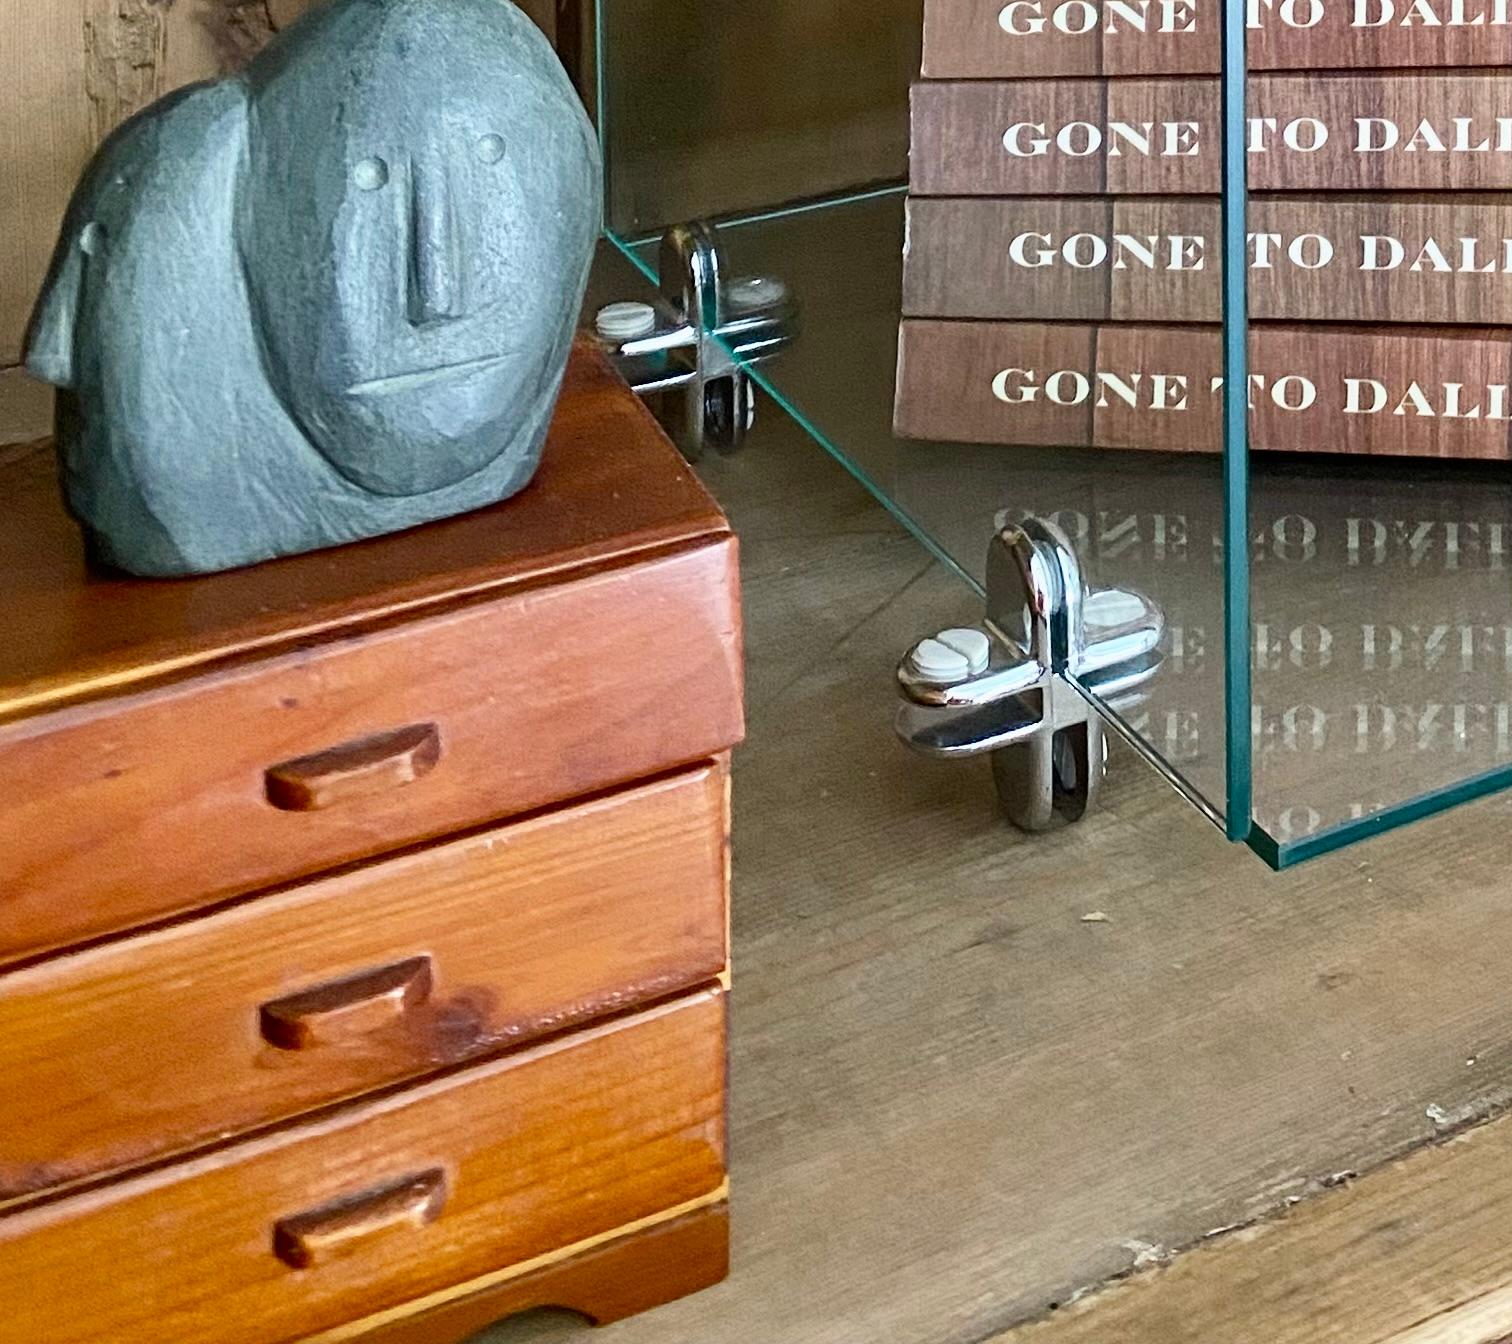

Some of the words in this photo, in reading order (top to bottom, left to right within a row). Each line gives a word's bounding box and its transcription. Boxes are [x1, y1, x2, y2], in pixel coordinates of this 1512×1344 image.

[999, 0, 1195, 35] GONE
[1003, 122, 1198, 156] GONE
[1247, 118, 1328, 152] TO
[1010, 233, 1204, 270] GONE
[1247, 233, 1333, 268] TO
[992, 369, 1186, 409] GONE
